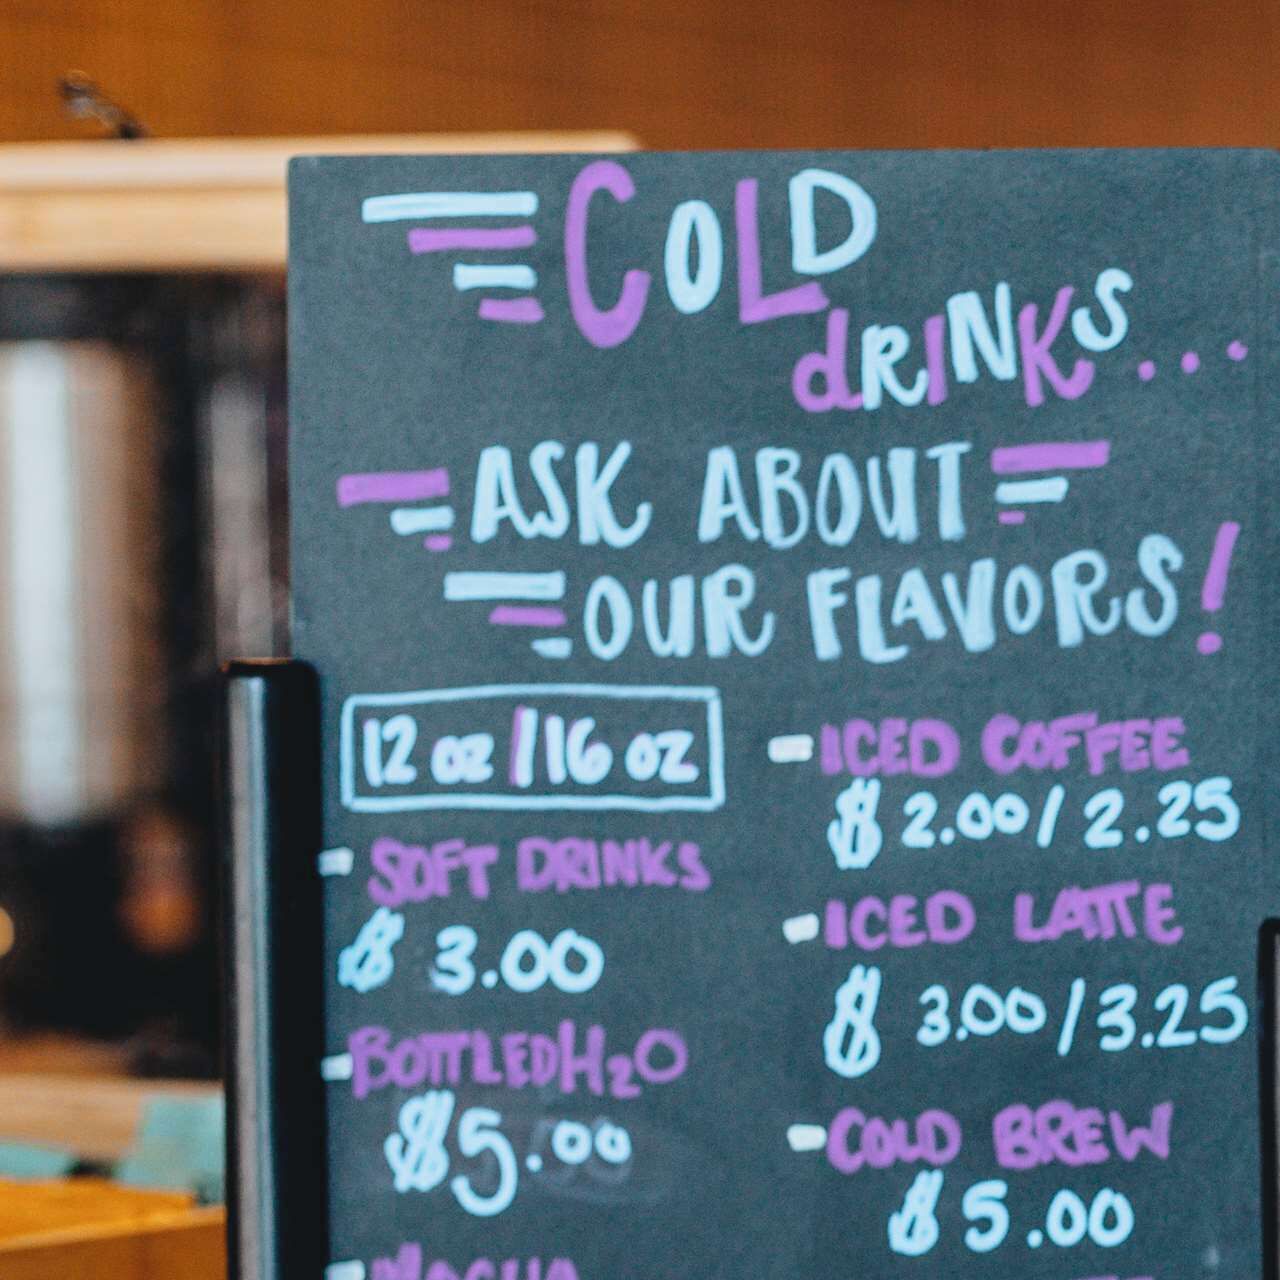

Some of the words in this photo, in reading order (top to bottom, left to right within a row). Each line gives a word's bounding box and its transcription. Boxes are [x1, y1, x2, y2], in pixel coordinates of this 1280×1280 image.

[565, 160, 878, 347] COLD
[471, 441, 652, 548] ASK
[698, 441, 971, 548] ABOUT
[584, 563, 774, 660] OUR
[807, 520, 1240, 662] FLAVORS!
[822, 718, 960, 775] ICED
[981, 713, 1188, 775] COFFEE
[368, 840, 497, 902] SOFT
[517, 838, 710, 892] DRINKS
[825, 892, 976, 948] ICED
[1013, 882, 1183, 945] LATTE
[827, 1109, 960, 1172] COLD
[993, 1102, 1172, 1168] BREW
